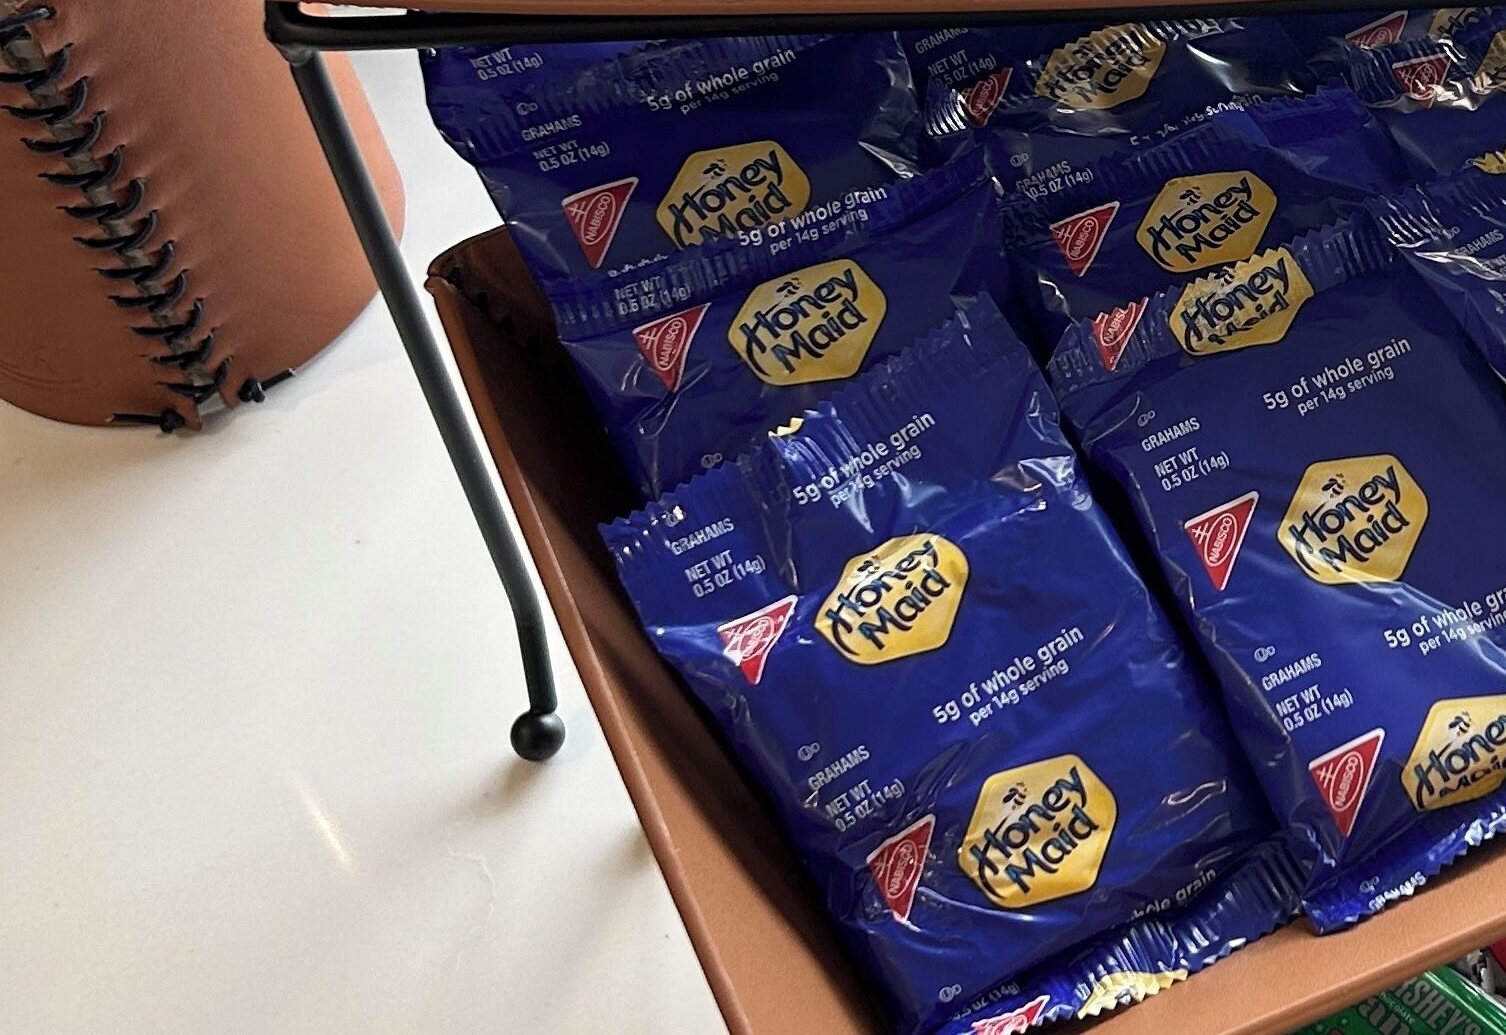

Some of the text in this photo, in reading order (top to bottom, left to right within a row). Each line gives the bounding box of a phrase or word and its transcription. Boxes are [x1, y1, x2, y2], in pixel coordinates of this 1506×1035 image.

[667, 150, 783, 250] Honey
[1147, 177, 1253, 268] Honey
[1176, 200, 1261, 264] Maid
[739, 268, 860, 377] Honey
[771, 300, 868, 374] Maid
[1262, 337, 1412, 410] 5g of whole grain
[1297, 364, 1395, 416] per 14g serving
[793, 412, 937, 505] 5g of whole grain
[1141, 416, 1201, 452] GRAHAMS
[1153, 447, 1199, 478] NET WT
[1160, 451, 1230, 492] 0.5 OZ (14g)
[670, 518, 735, 556] GRAHAMS
[1208, 517, 1232, 563] NABISCO
[1288, 465, 1400, 576] Honey
[1319, 500, 1410, 573] Maid
[684, 549, 733, 584] NET WT
[825, 539, 939, 656] Honey
[857, 566, 952, 651] Maid
[1383, 628, 1411, 648] 5g
[1412, 614, 1431, 637] of
[1432, 600, 1483, 629] whole
[933, 626, 1085, 724] 5g of whole grain
[969, 657, 1070, 726] per 14g serving
[1261, 653, 1322, 692] GRAHAMS
[1275, 684, 1322, 716] NET WT
[1283, 688, 1355, 732] 0.5 OZ (14g)
[808, 745, 871, 791] GRAHAMS
[825, 779, 872, 817] NET WT
[969, 765, 1088, 899] Honey
[1004, 805, 1100, 894] Maid
